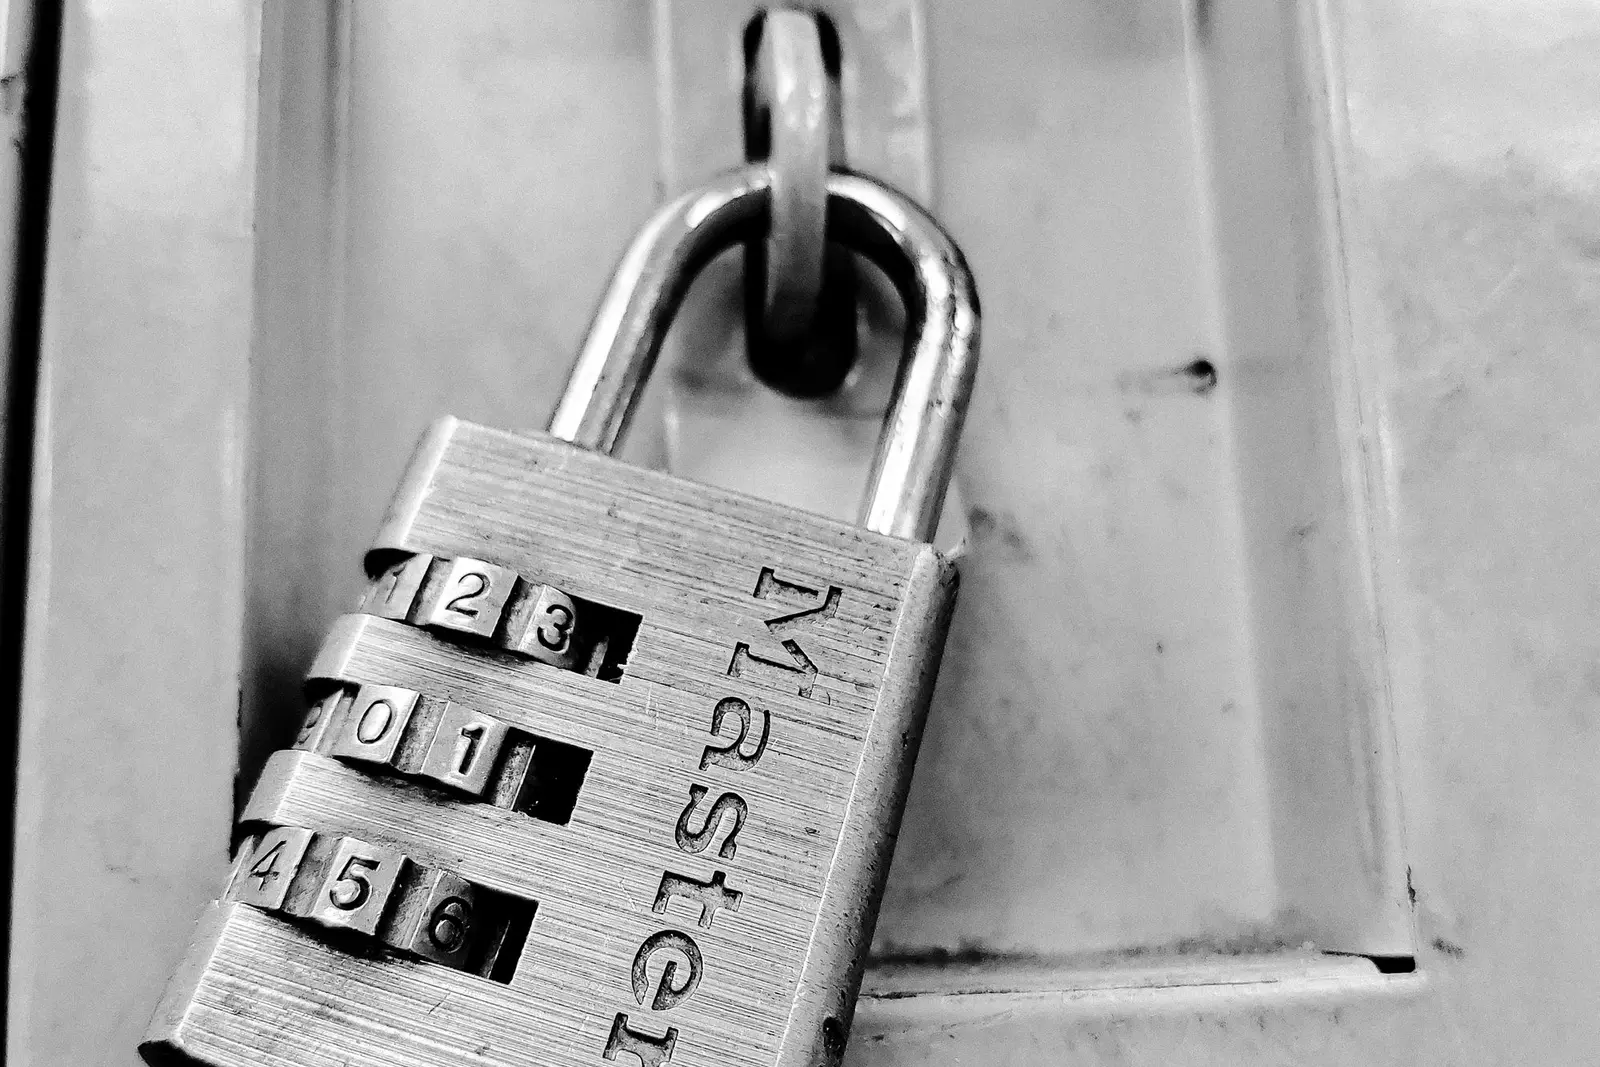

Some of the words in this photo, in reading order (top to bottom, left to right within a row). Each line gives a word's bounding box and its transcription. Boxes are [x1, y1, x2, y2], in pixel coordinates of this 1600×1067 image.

[446, 571, 492, 616] 2
[536, 602, 577, 653] 3
[357, 699, 398, 744] 0
[248, 838, 288, 891] 4
[328, 855, 381, 912] 5
[428, 896, 473, 954] 6
